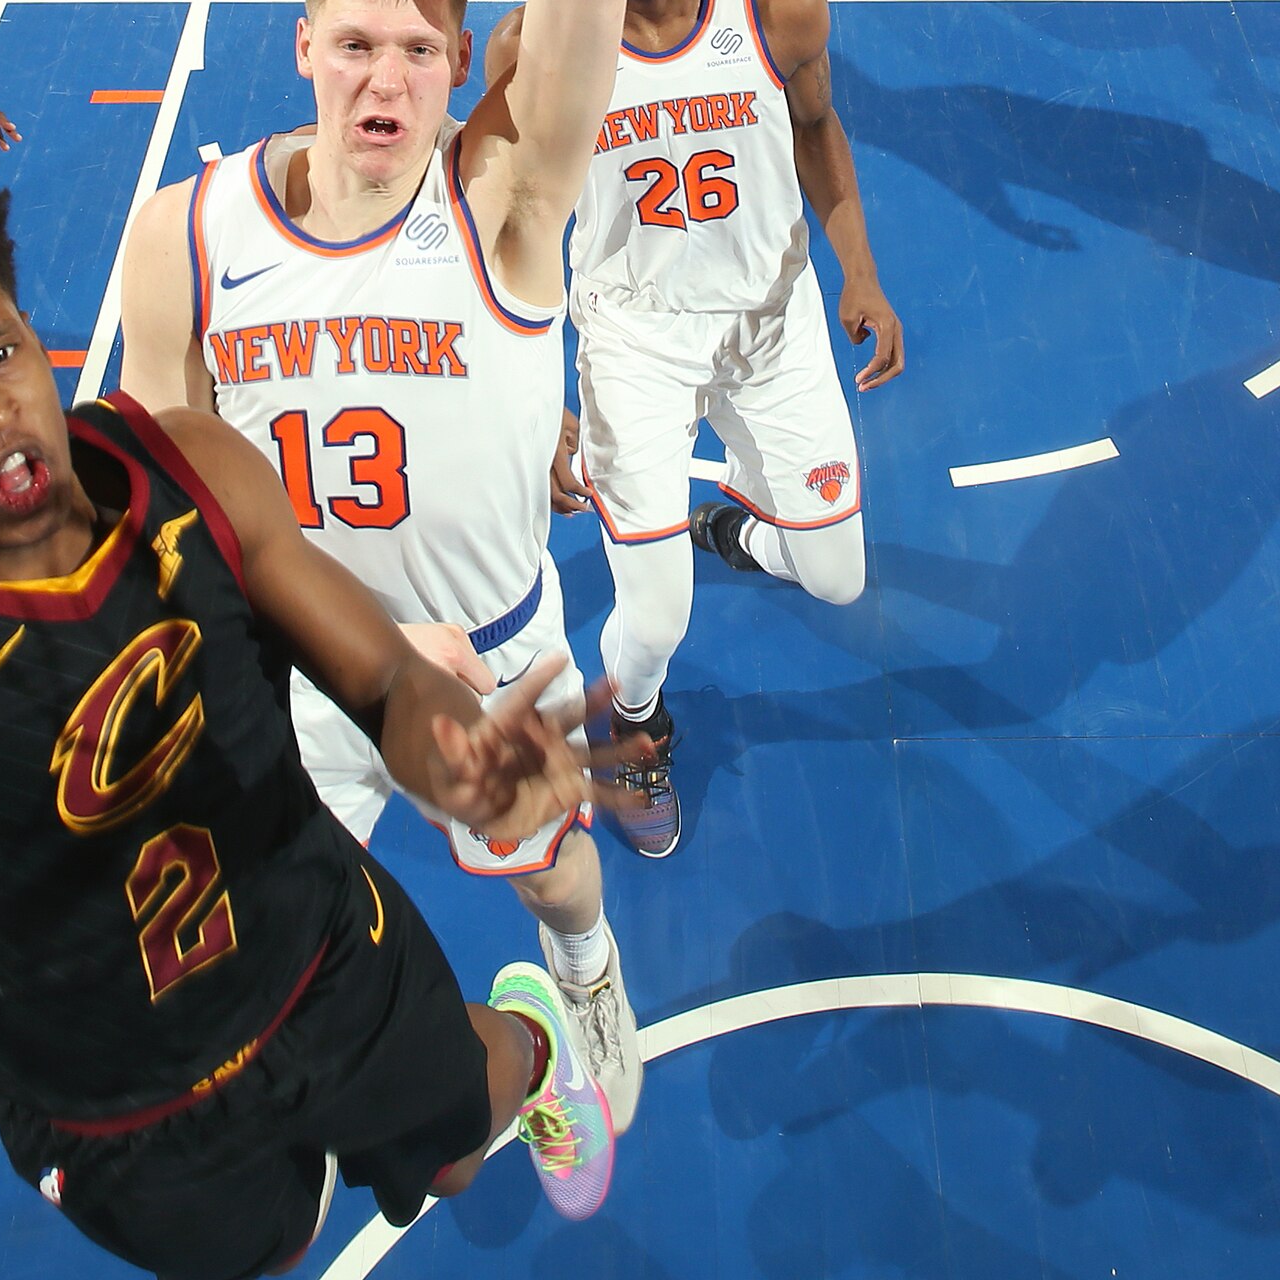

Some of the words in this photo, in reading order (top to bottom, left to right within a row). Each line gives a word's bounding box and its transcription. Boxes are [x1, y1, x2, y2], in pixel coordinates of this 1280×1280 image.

[706, 56, 752, 68] SQUARESPACE
[661, 90, 759, 135] YORK
[623, 149, 740, 233] 26
[395, 255, 460, 266] SQUARESPACE
[209, 322, 336, 387] NEW
[327, 315, 470, 379] YORK
[270, 405, 415, 531] 13
[50, 619, 204, 835] C
[125, 823, 238, 1007] 2
